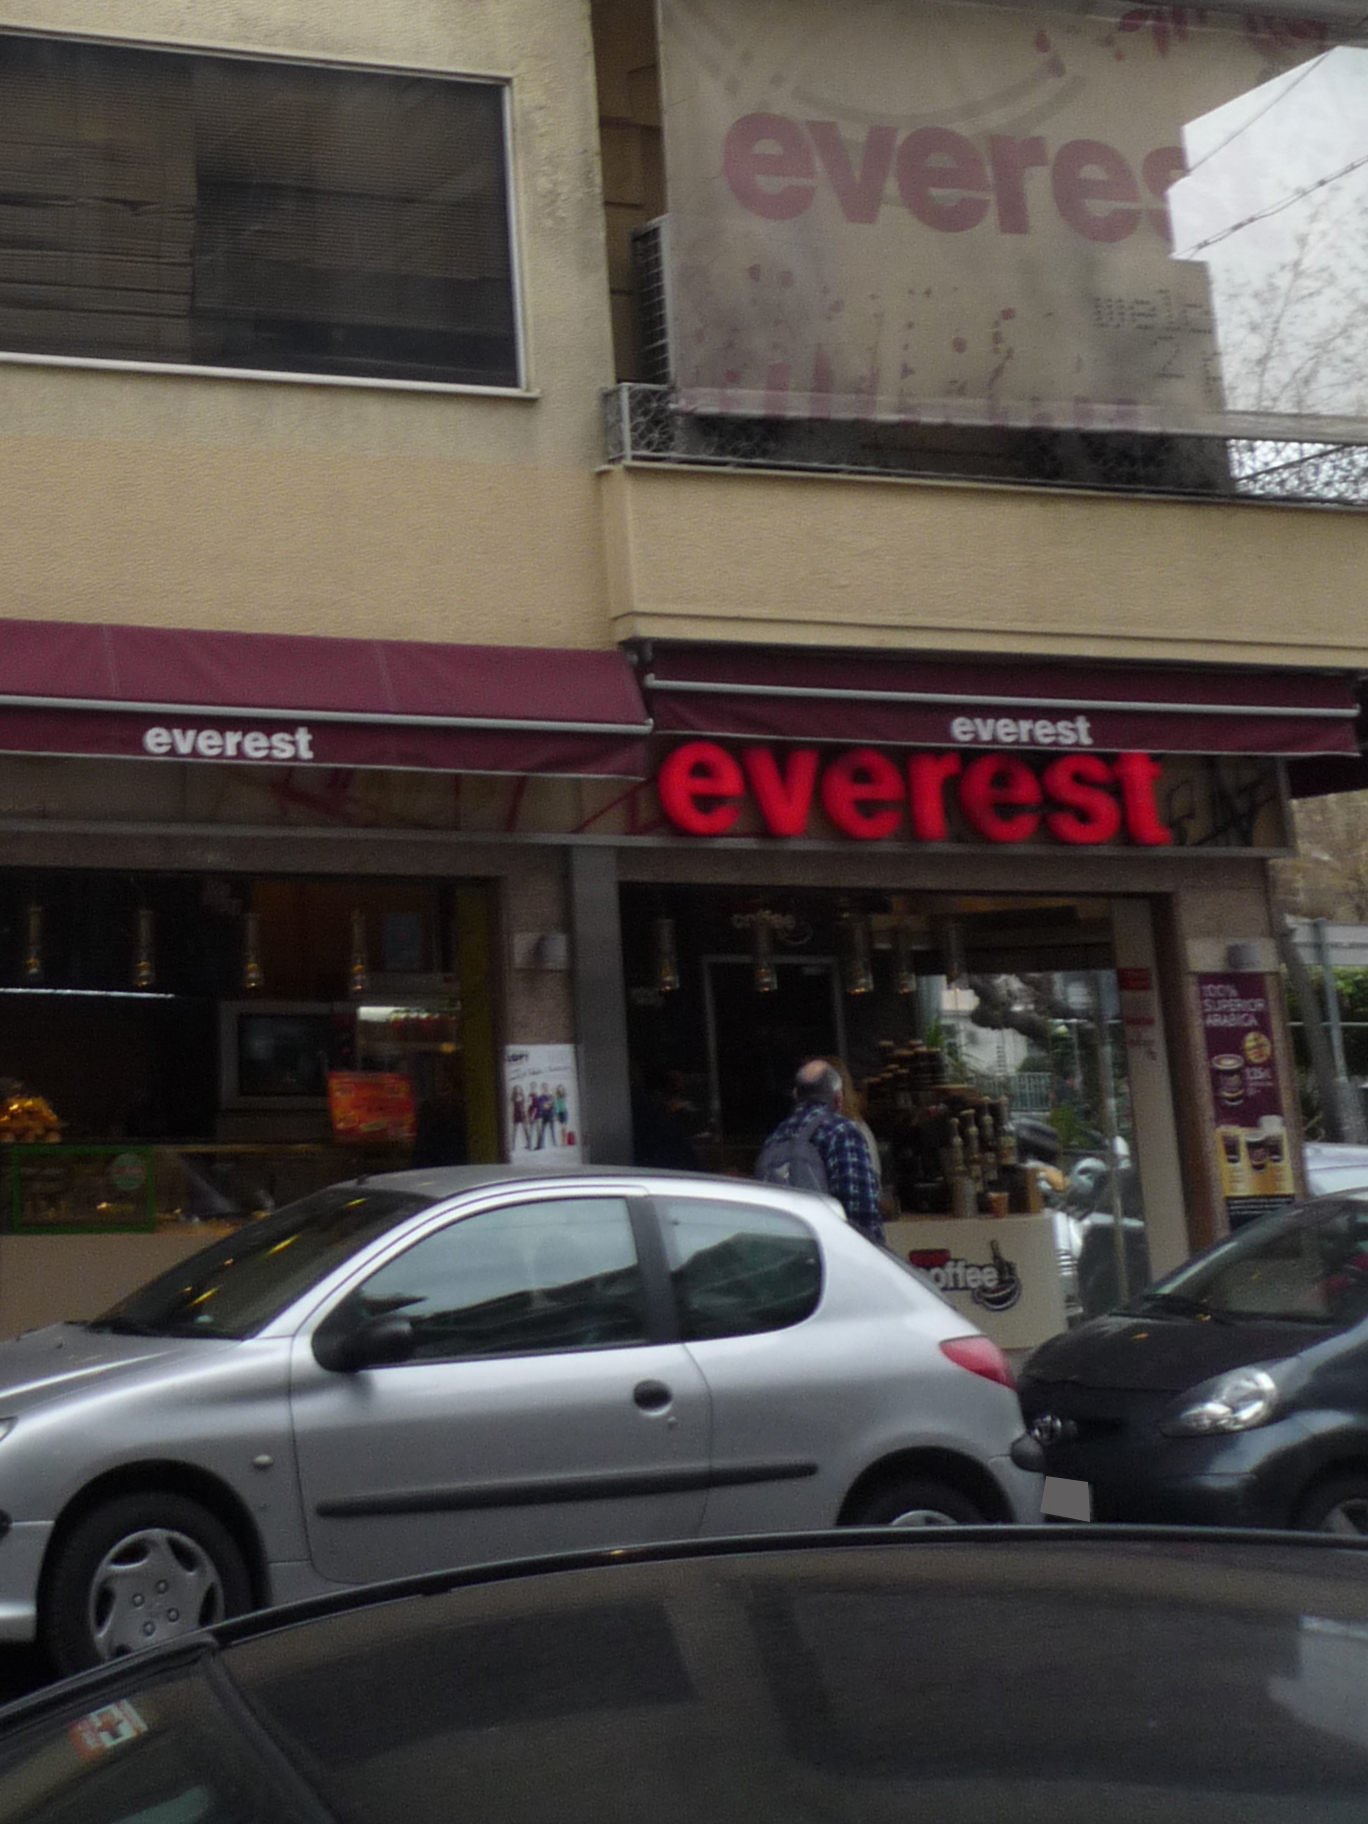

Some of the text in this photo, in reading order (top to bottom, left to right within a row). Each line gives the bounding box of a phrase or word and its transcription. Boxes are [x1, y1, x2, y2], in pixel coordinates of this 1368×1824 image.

[952, 715, 1094, 746] everest
[144, 727, 314, 760] everest
[658, 741, 1173, 845] everest
[1201, 984, 1238, 997] 100%
[1203, 998, 1266, 1013] SUPERIOR
[1205, 1013, 1259, 1027] ARABICA
